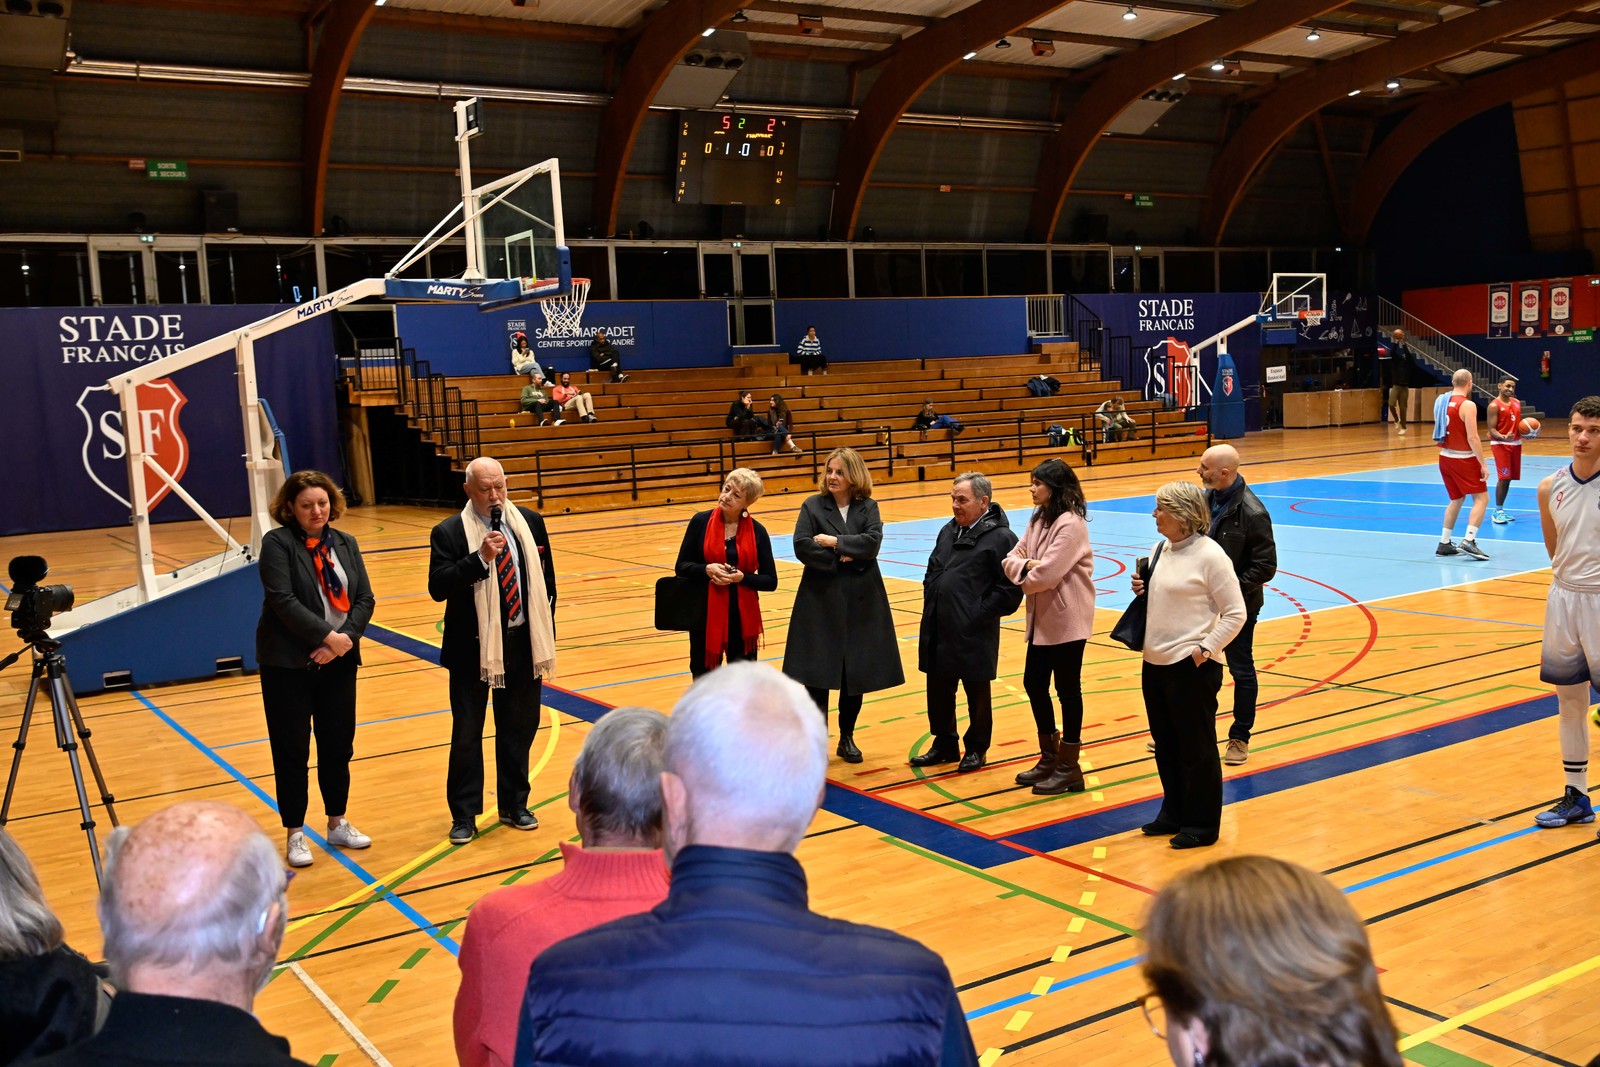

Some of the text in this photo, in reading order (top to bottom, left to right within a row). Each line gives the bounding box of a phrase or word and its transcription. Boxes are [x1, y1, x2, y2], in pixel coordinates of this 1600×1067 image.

[722, 116, 730, 129] 5
[738, 118, 745, 129] 2
[768, 119, 775, 131] 2
[705, 142, 712, 153] 0
[767, 146, 774, 156] 0
[427, 285, 467, 298] MARTY
[298, 296, 334, 319] MARTY
[1138, 299, 1194, 318] STADE
[59, 314, 184, 343] STADE
[1139, 319, 1194, 331] FRANÇAIS
[1556, 491, 1563, 510] 9
